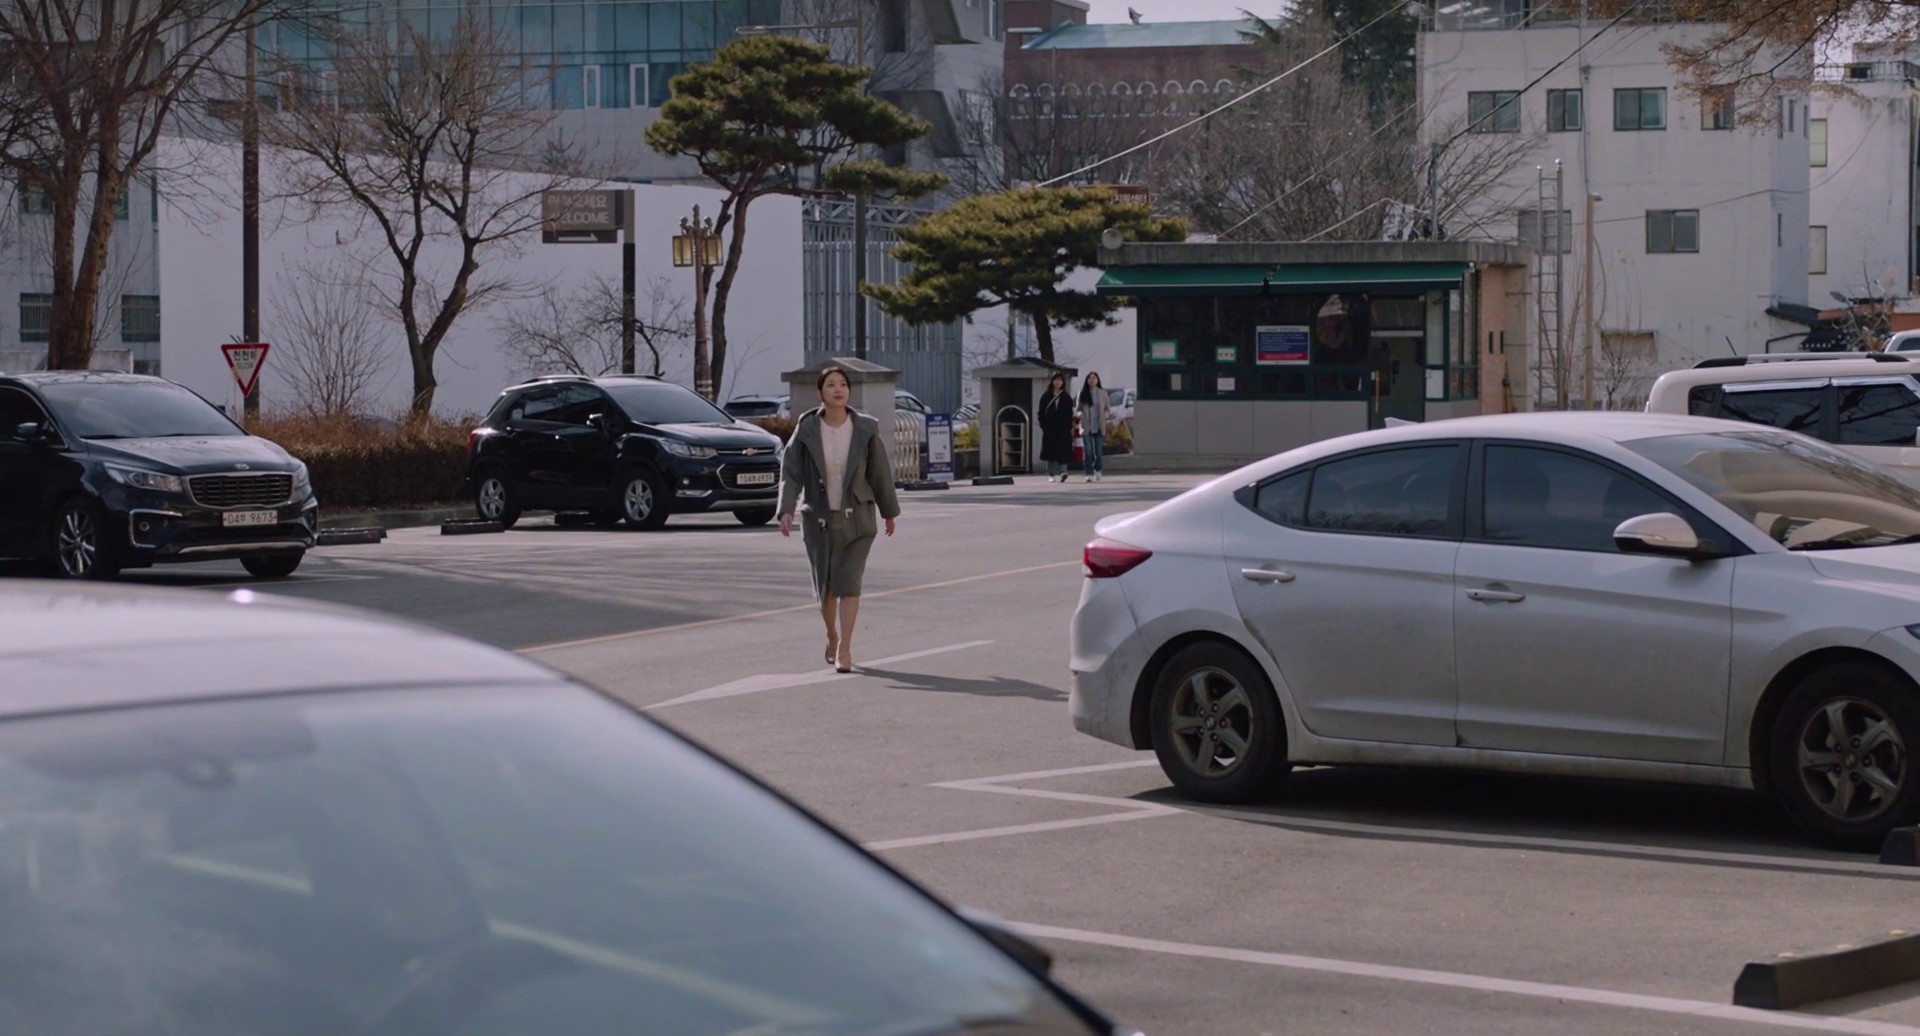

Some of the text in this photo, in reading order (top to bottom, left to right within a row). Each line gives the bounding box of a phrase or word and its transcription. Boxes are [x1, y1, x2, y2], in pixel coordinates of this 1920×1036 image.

[548, 211, 610, 224] ELCOME
[233, 350, 257, 361] 천천히
[250, 512, 273, 523] 9673
